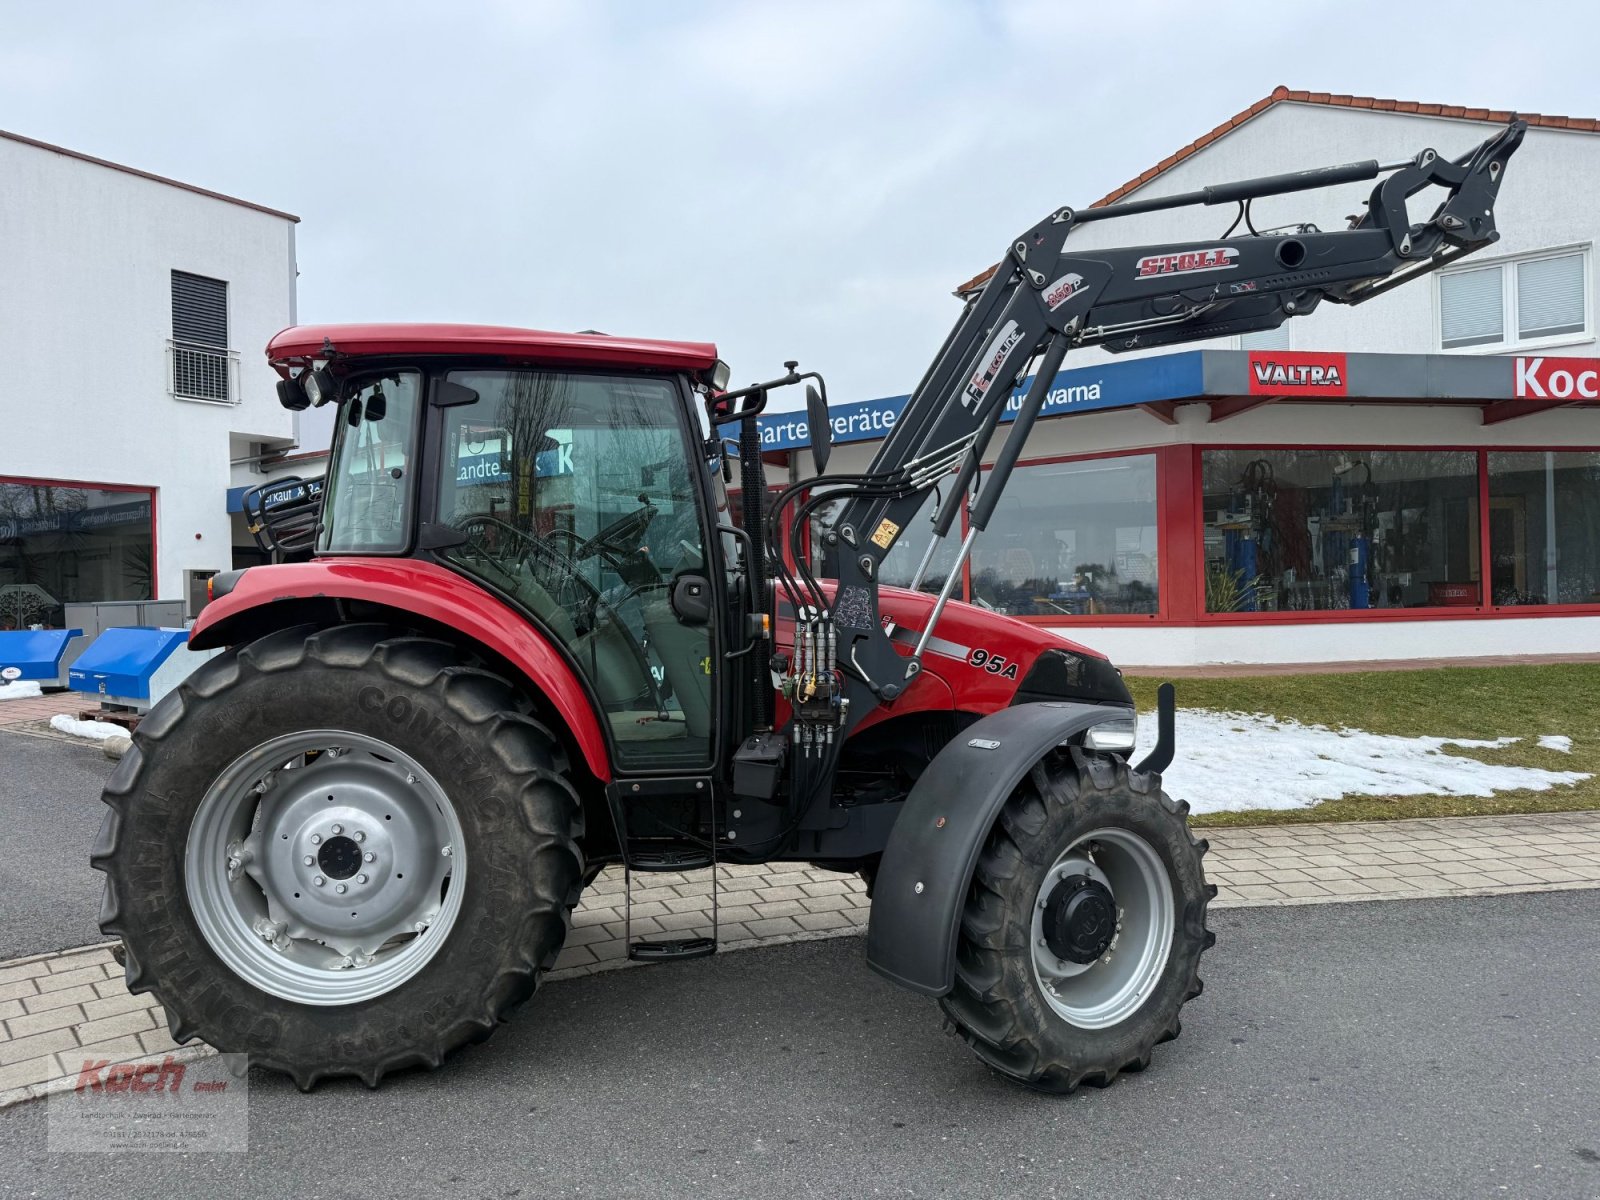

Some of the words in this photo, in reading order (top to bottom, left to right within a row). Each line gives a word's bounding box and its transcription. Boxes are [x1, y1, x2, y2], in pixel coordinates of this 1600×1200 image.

[1140, 249, 1230, 276] STOLL
[1252, 361, 1342, 386] VALTRA
[969, 648, 1018, 681] 95A
